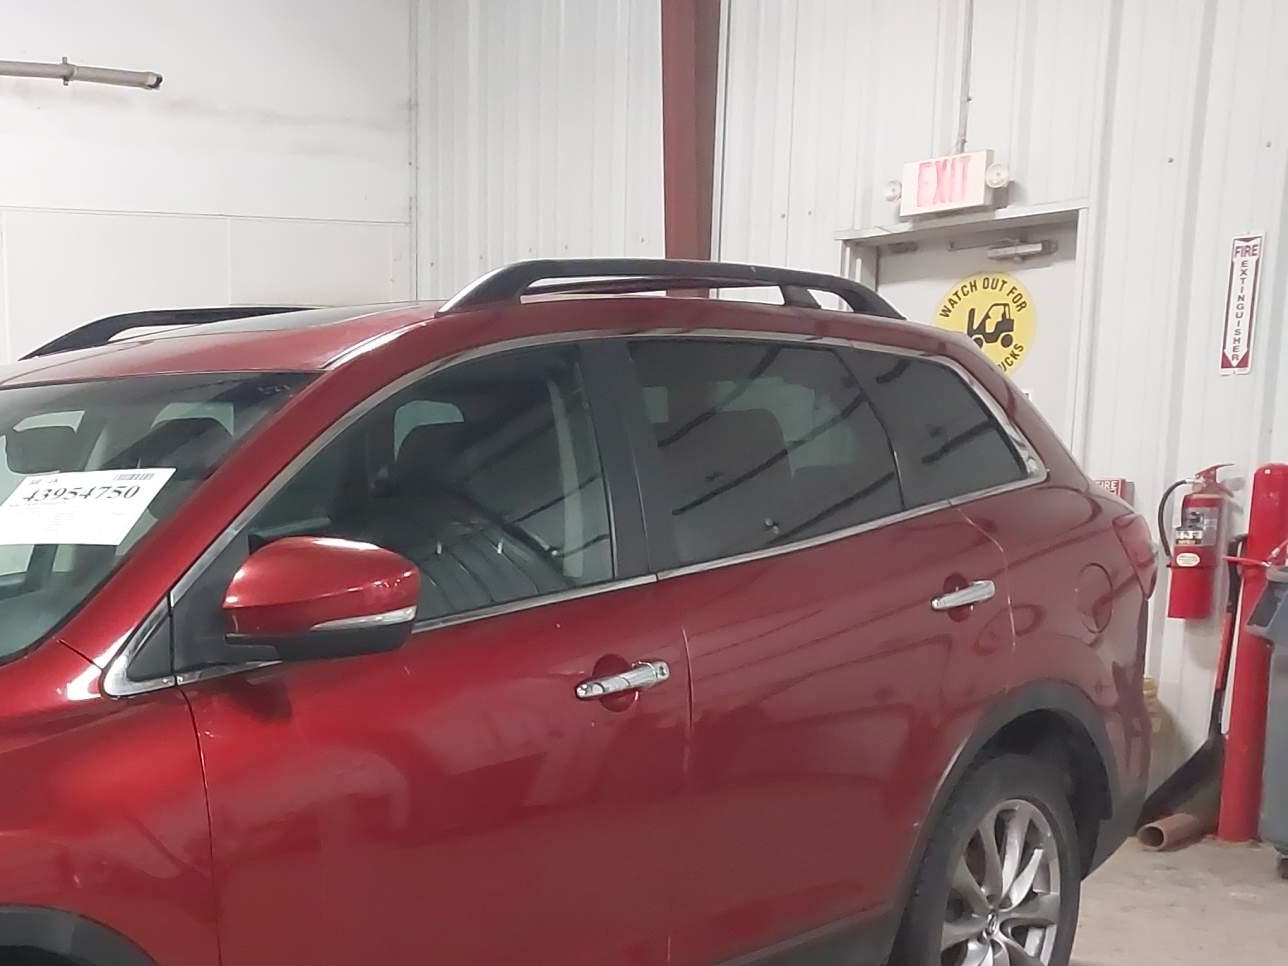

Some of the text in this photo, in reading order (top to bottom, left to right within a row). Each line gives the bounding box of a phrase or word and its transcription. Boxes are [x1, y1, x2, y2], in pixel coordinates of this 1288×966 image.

[916, 154, 972, 208] EXIT
[1234, 244, 1259, 258] FIRE
[938, 276, 1028, 318] WATCH OUT FOR
[1231, 260, 1249, 361] EXTINGUISHER
[22, 484, 141, 502] 43954750
